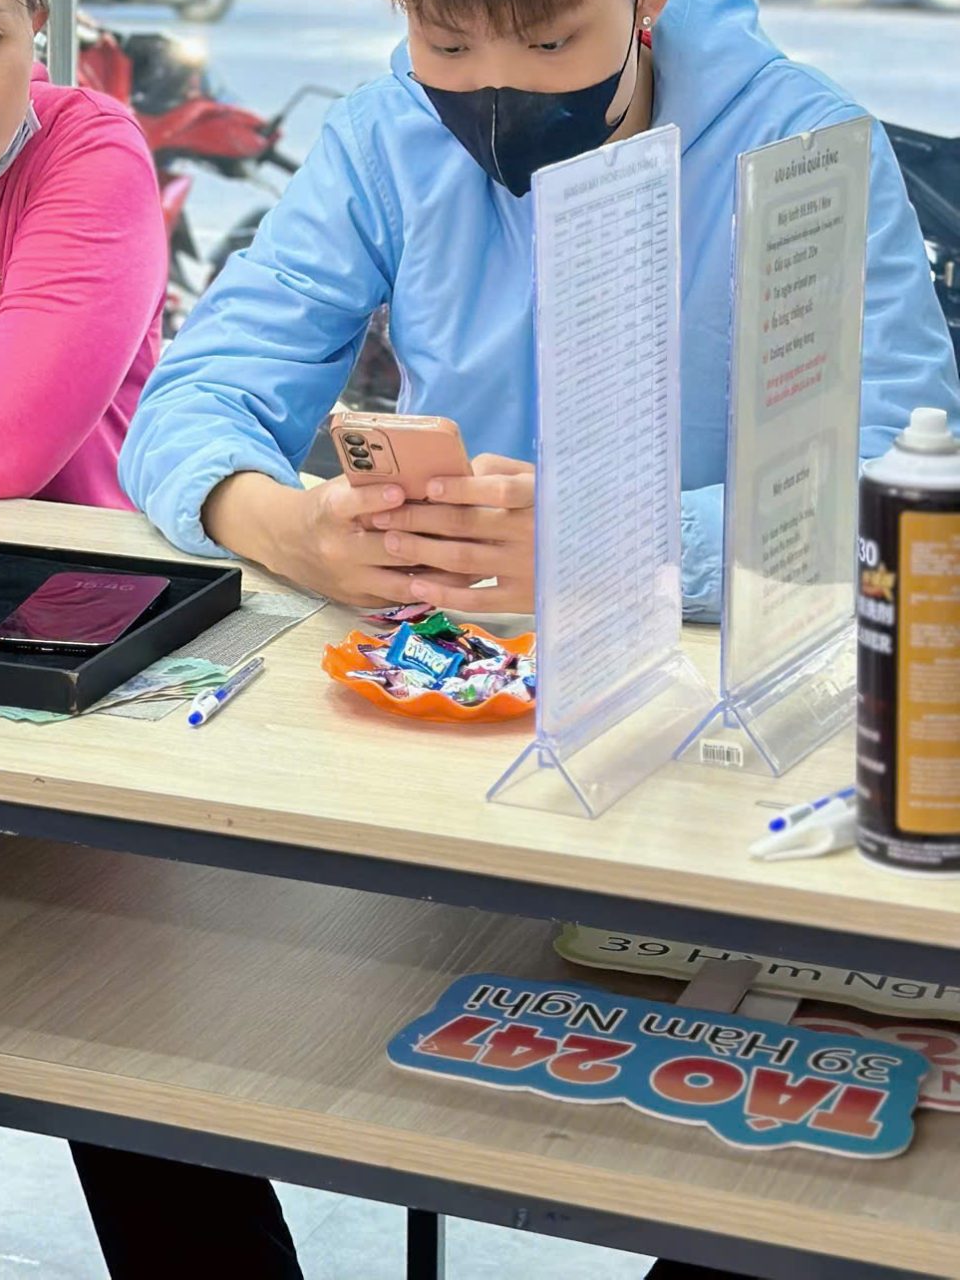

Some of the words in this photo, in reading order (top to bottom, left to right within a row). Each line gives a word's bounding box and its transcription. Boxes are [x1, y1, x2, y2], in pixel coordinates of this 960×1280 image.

[598, 936, 670, 956] 39
[686, 948, 822, 981] Hm
[464, 984, 627, 1034] Nghi
[414, 1014, 636, 1085] 247
[639, 1013, 799, 1064] Hàm
[807, 1047, 902, 1083] 39
[649, 1055, 889, 1139] TÁO
